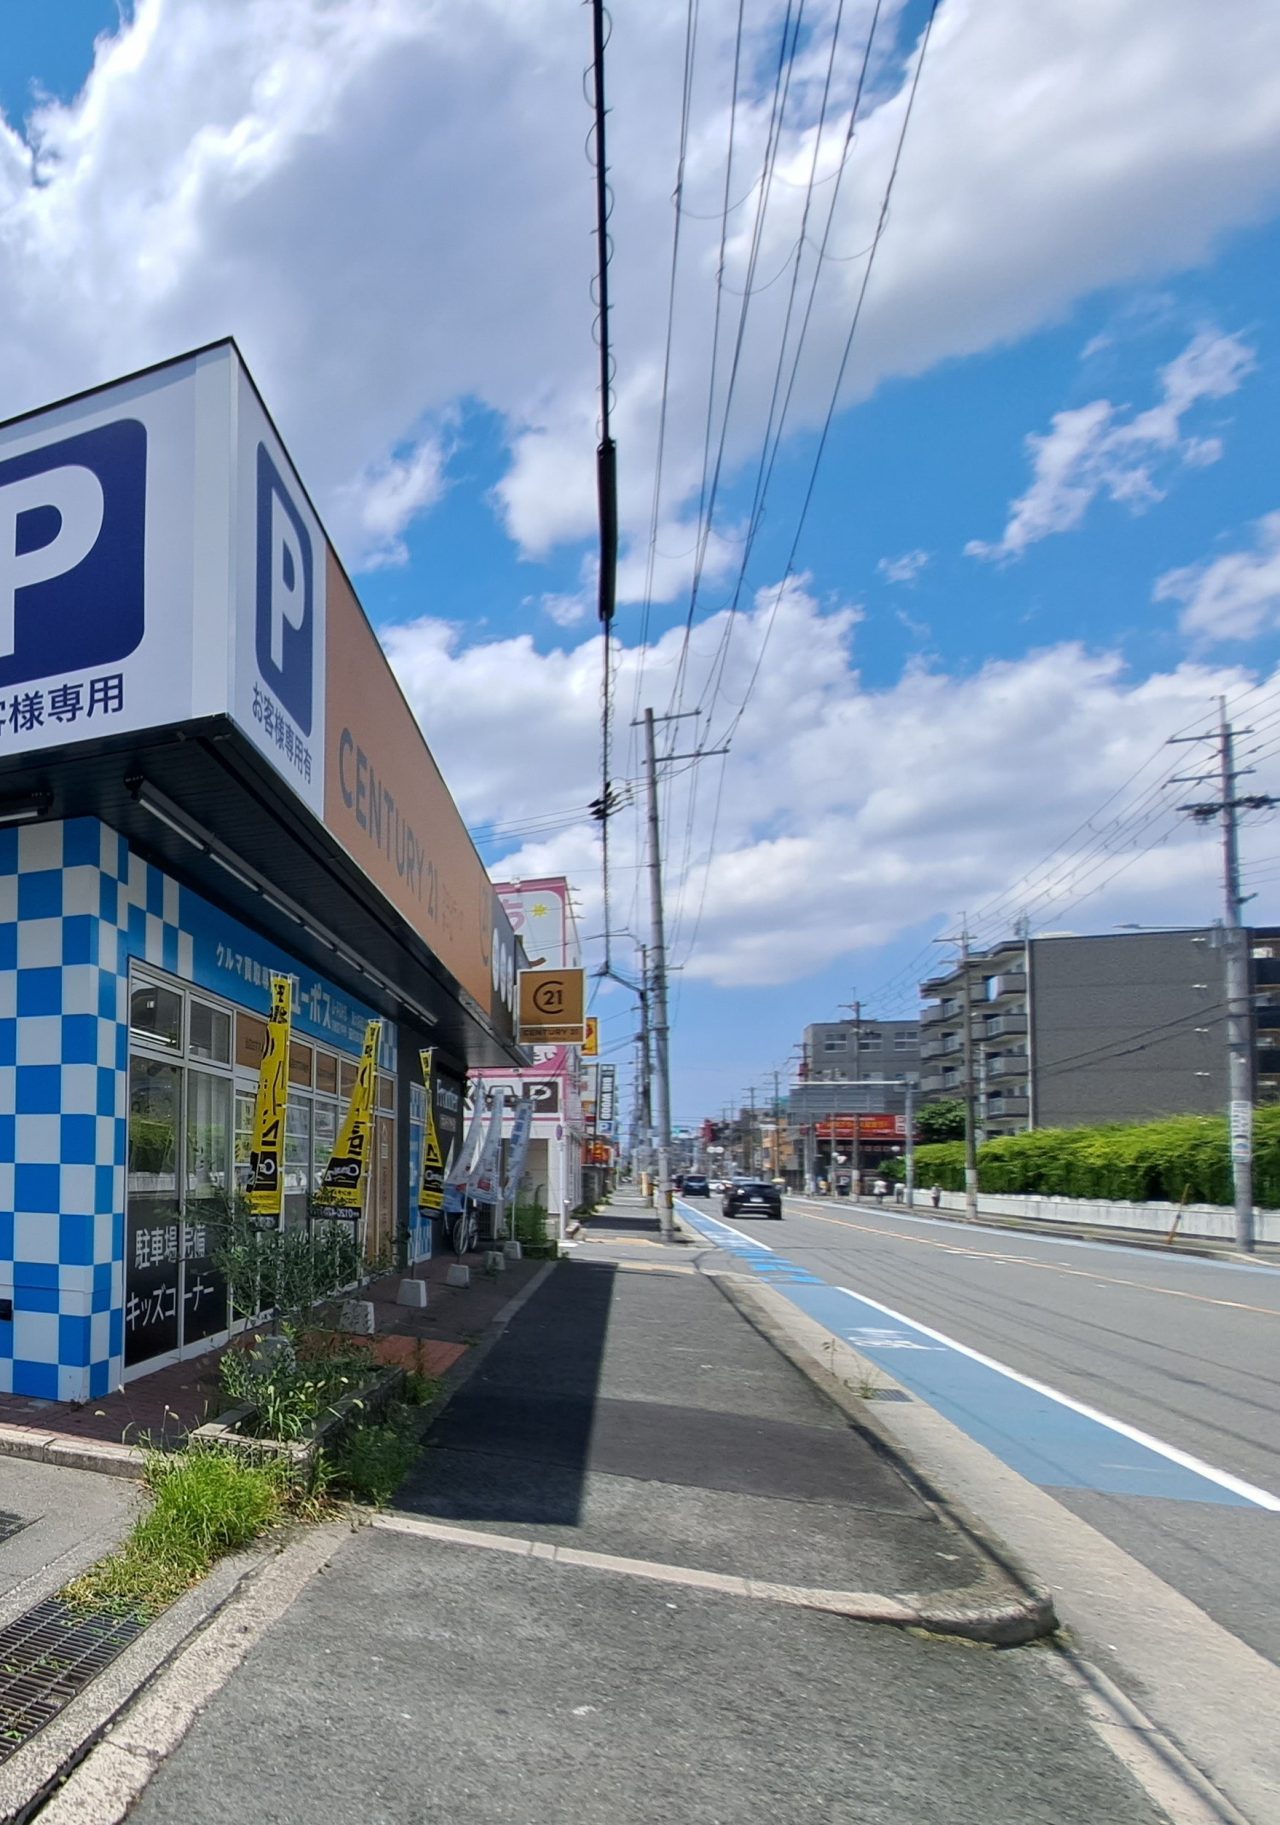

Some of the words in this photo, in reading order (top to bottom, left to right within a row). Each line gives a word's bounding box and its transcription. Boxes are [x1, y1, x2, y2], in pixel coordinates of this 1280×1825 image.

[272, 486, 306, 674] P
[339, 727, 425, 903] CENTURY
[601, 1093, 613, 1120] WOOD
[126, 1276, 215, 1331] キッズコーナー
